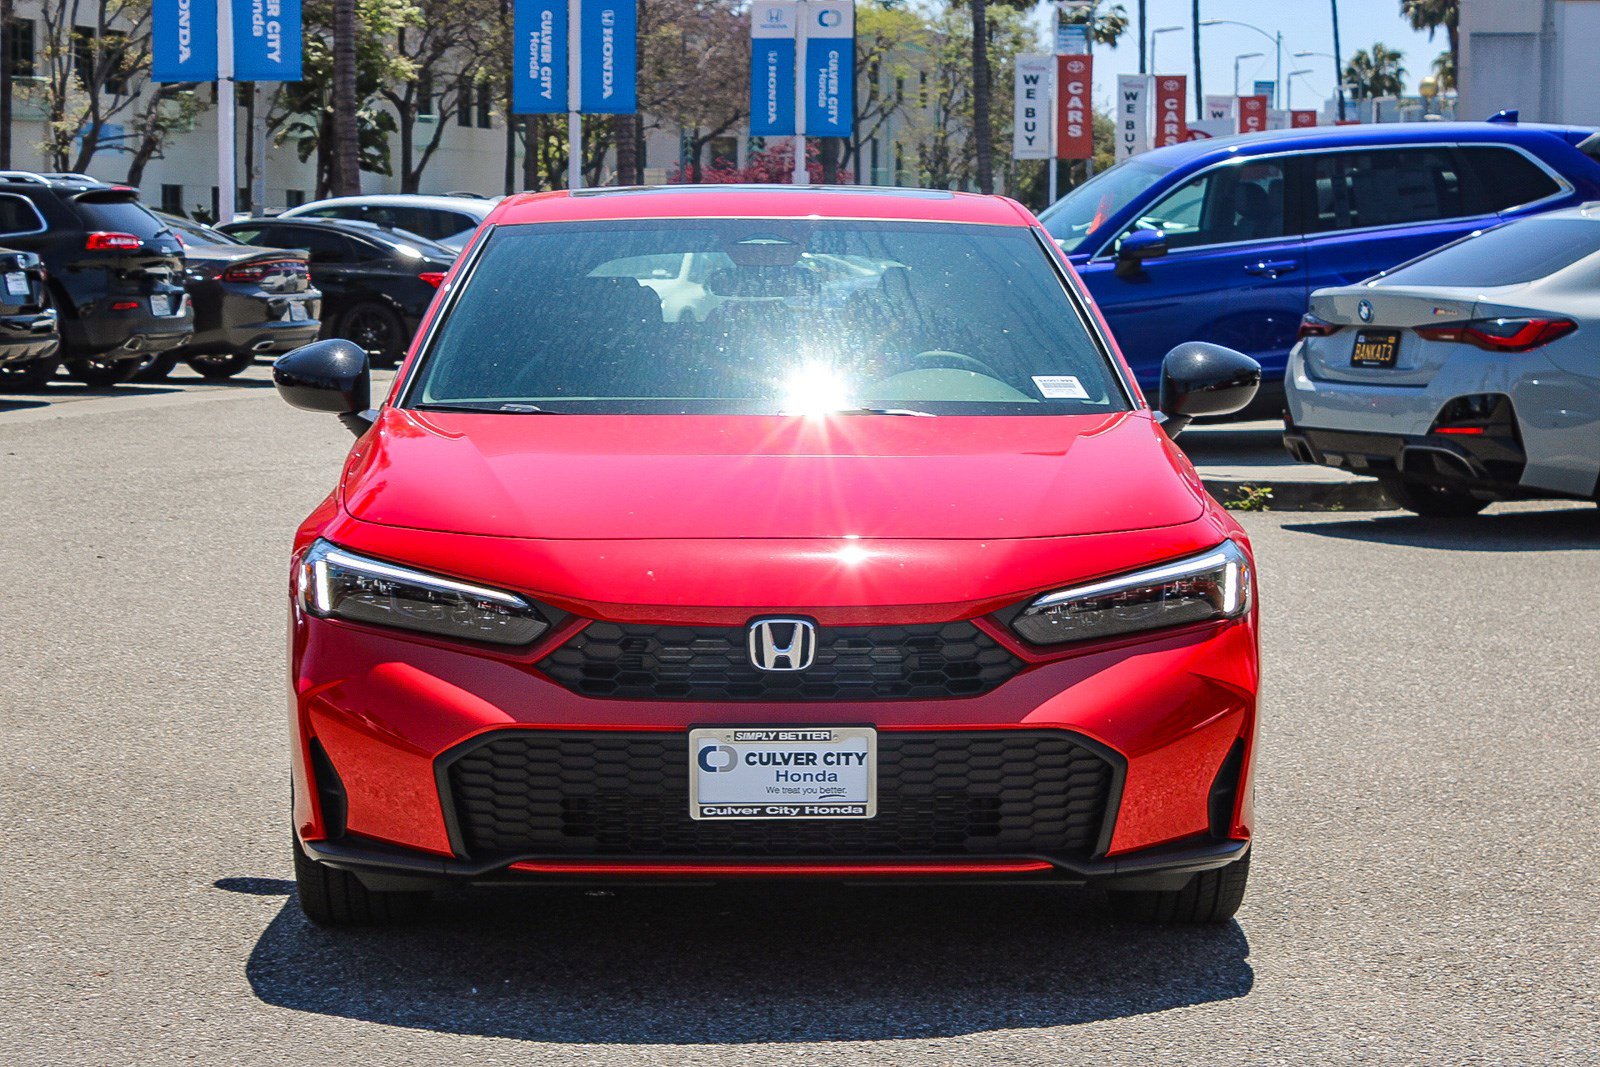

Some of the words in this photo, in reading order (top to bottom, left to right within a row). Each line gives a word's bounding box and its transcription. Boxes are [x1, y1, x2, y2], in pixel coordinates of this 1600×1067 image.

[266, 20, 281, 64] CITY
[541, 10, 553, 63] CULVER
[529, 31, 540, 79] Honda
[602, 27, 613, 99] HONDA
[828, 50, 839, 95] CULVER
[541, 66, 552, 99] CITY
[767, 65, 777, 124] HONDA
[818, 68, 828, 108] Honda
[1023, 74, 1039, 99] WE
[827, 97, 838, 125] CITY
[1024, 107, 1036, 146] BUY
[1067, 81, 1084, 137] CARS
[1125, 121, 1135, 155] BUY
[735, 732, 776, 741] SIMPLY
[778, 731, 830, 740] BETTER
[745, 752, 817, 766] CULVER
[823, 752, 868, 766] CITY
[776, 770, 838, 783] Honda
[766, 786, 780, 794] We
[782, 786, 800, 794] treat
[802, 787, 818, 796] you
[819, 786, 848, 795] better.
[703, 807, 761, 816] Culver
[765, 806, 800, 816] City
[805, 806, 863, 815] Honda
